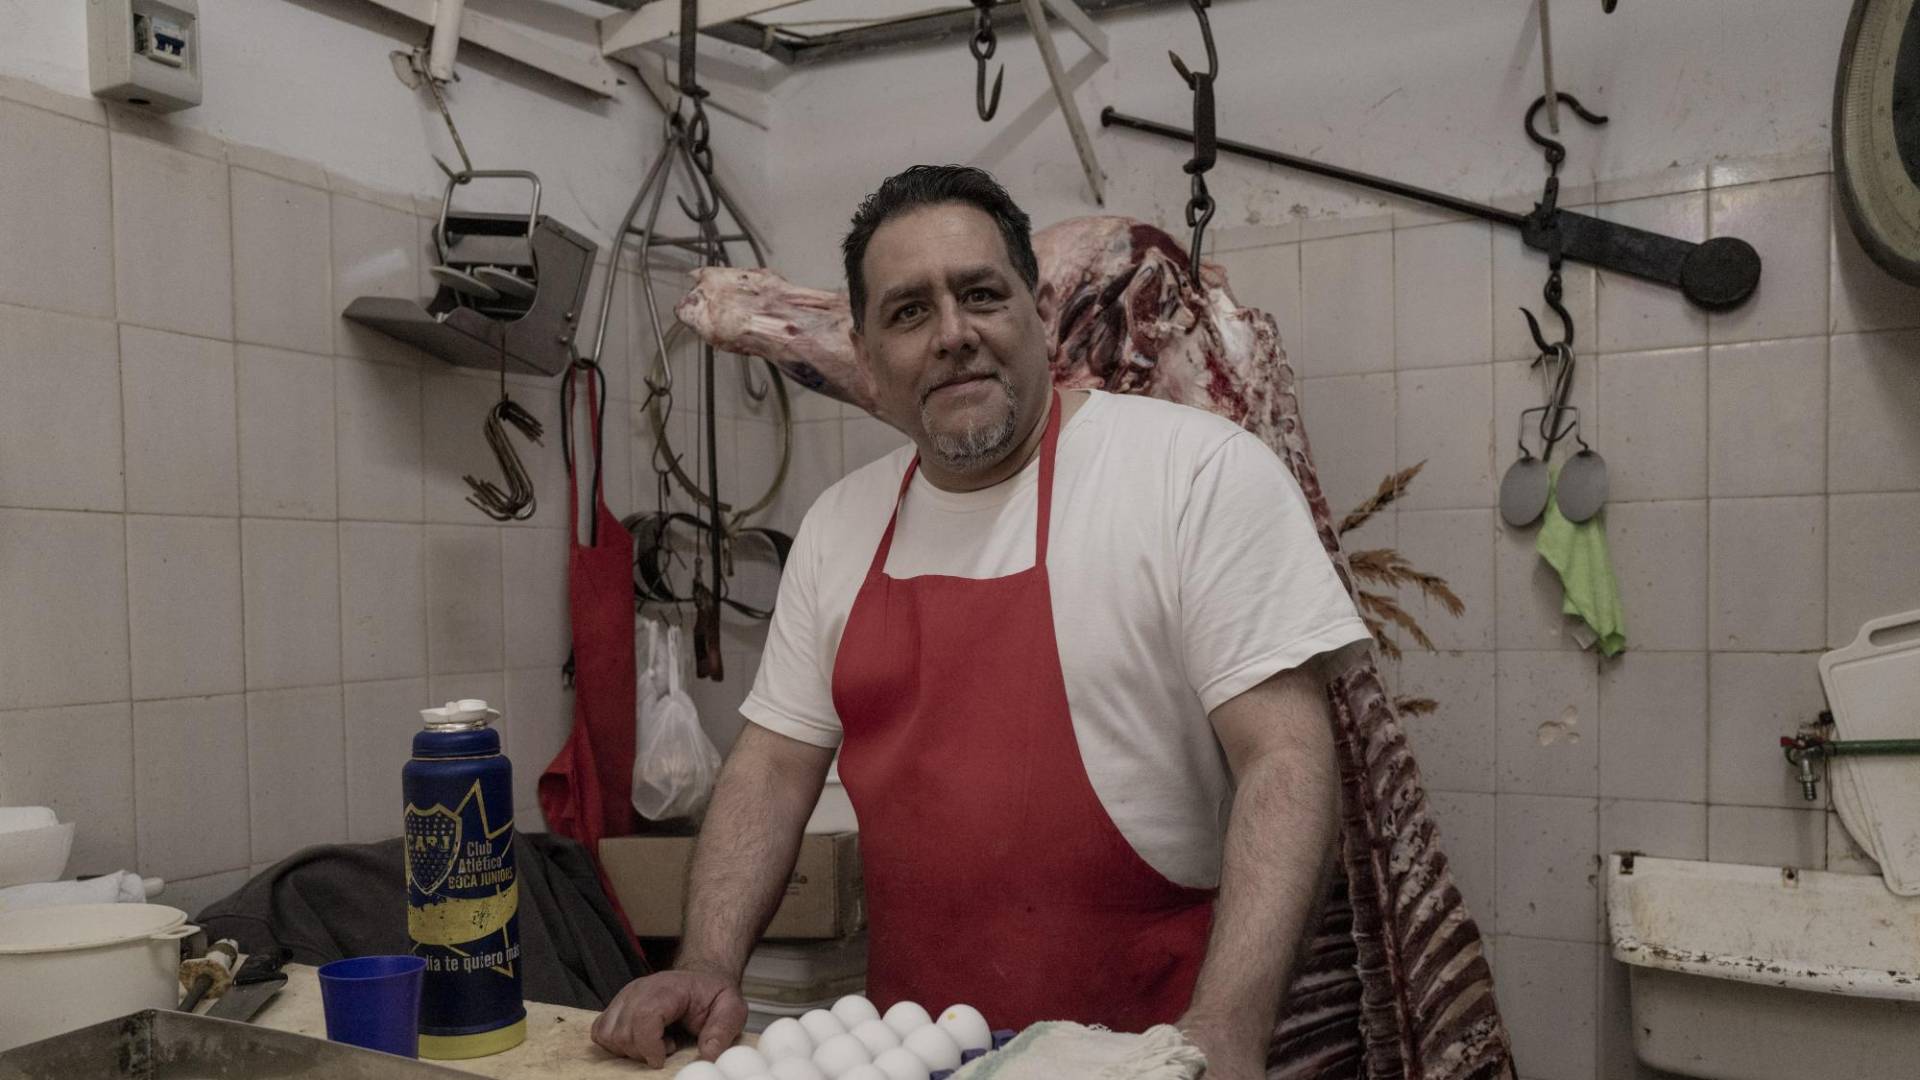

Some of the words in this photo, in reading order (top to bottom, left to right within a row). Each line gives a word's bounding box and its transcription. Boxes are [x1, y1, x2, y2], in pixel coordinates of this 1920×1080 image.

[466, 840, 493, 857] Club
[458, 855, 502, 874] Atlético
[448, 874, 478, 889] BOCA
[480, 866, 514, 886] JUNIORS
[445, 955, 459, 972] te
[463, 951, 503, 974] quiero
[506, 942, 520, 962] más
